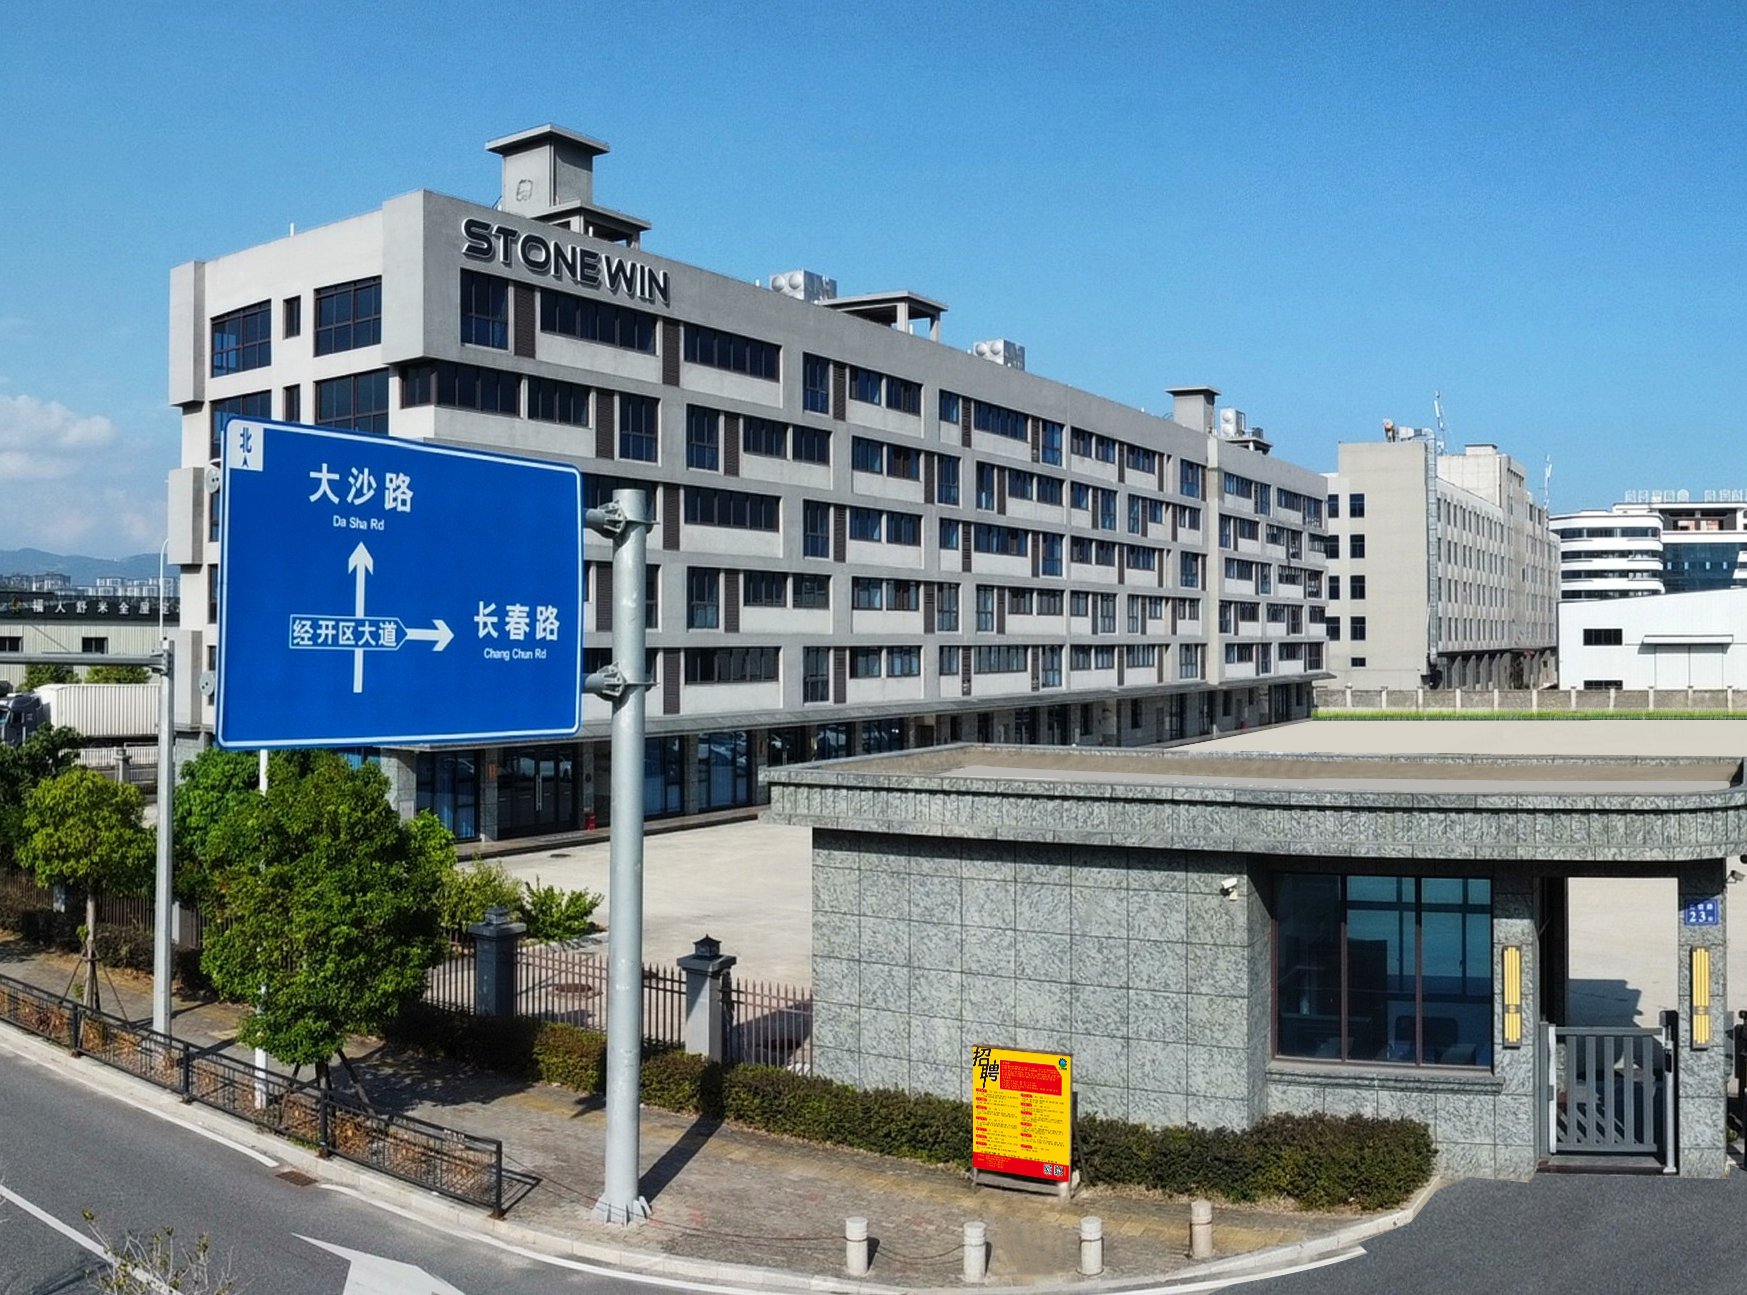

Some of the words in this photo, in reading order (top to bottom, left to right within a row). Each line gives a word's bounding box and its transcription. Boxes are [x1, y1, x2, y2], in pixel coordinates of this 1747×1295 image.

[461, 218, 670, 306] STONEWIN
[240, 427, 252, 453] 北
[309, 463, 413, 512] 大沙路
[333, 515, 346, 527] Da
[349, 516, 367, 530] Sha
[370, 518, 384, 530] Rd
[293, 619, 397, 647] 经开区大道
[474, 601, 560, 640] 长春路
[484, 648, 510, 661] Chang
[512, 648, 533, 659] Chun
[535, 648, 547, 659] Rd
[972, 1046, 999, 1089] 招聘
